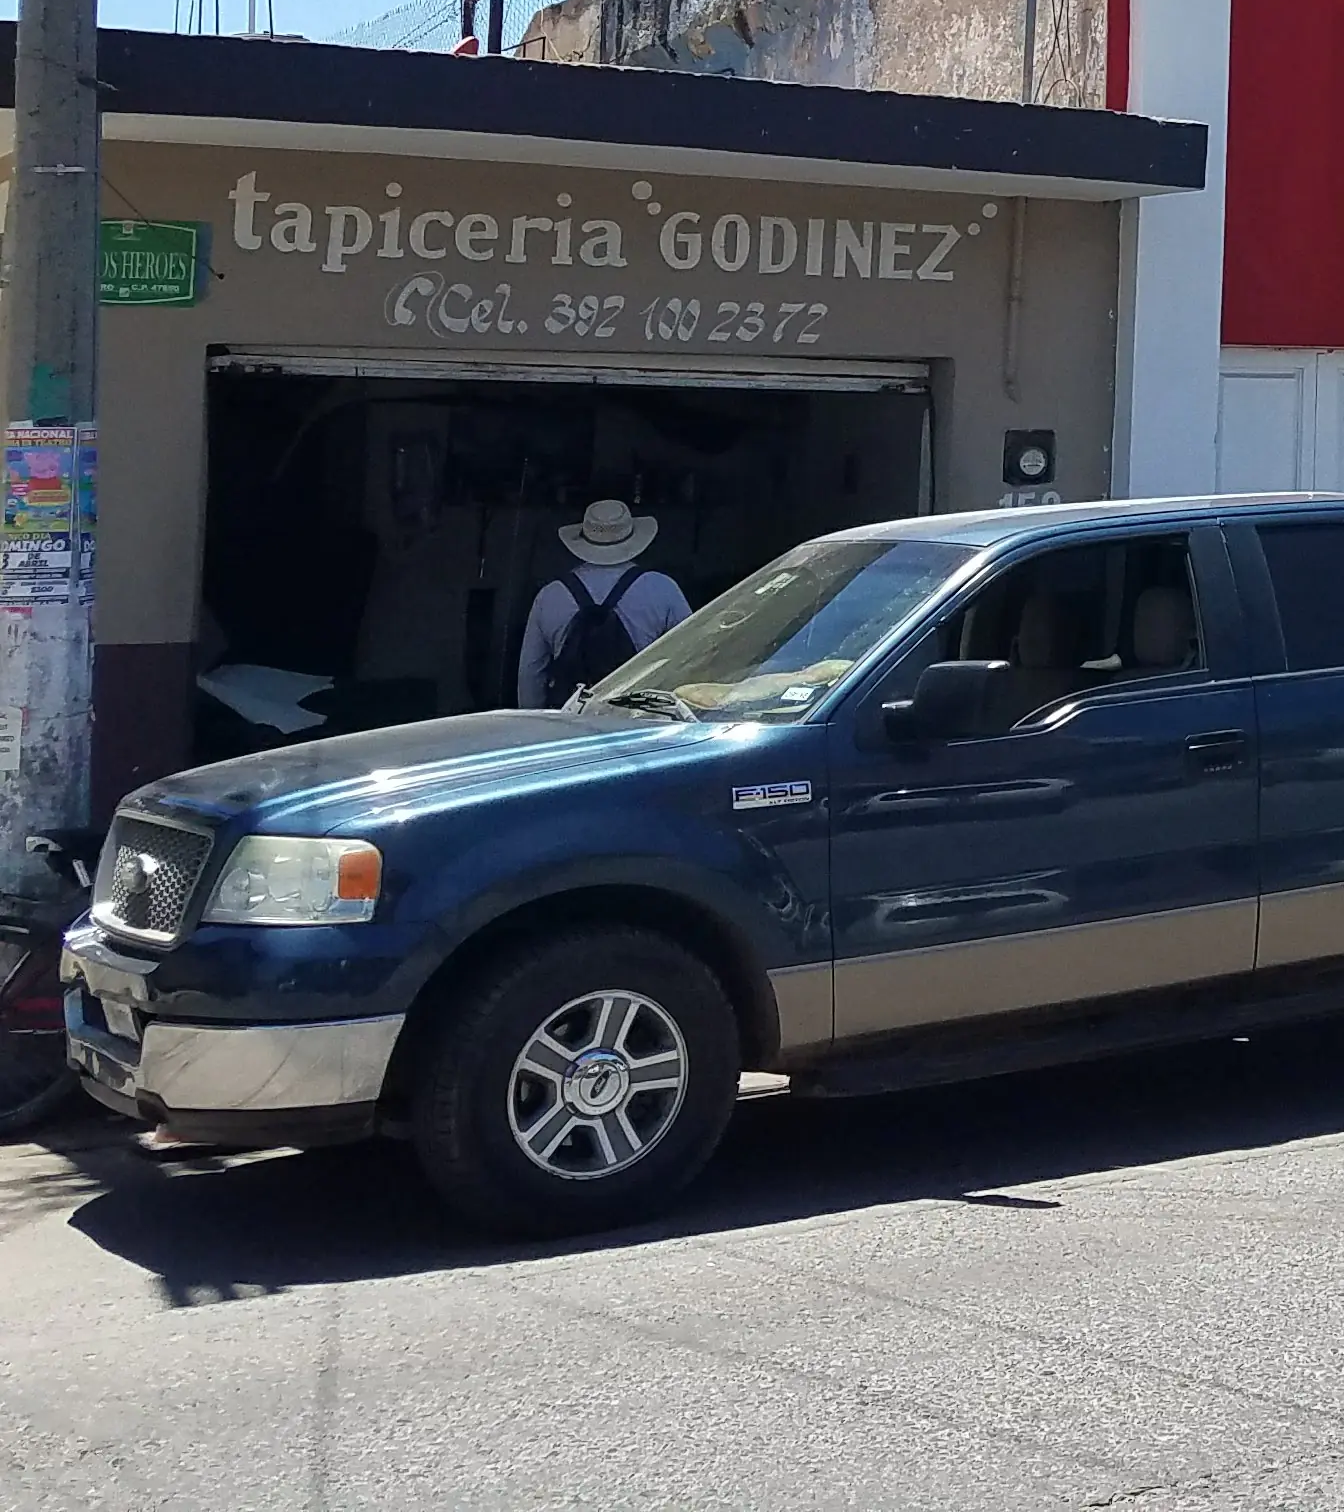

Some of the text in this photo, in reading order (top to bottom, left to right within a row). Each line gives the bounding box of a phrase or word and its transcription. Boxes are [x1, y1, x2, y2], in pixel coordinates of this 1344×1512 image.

[228, 170, 962, 282] tapiceria GODINEZ
[121, 251, 187, 280] HEROES
[438, 283, 528, 335] Cel.
[543, 293, 625, 337] 392
[639, 295, 701, 342] 100
